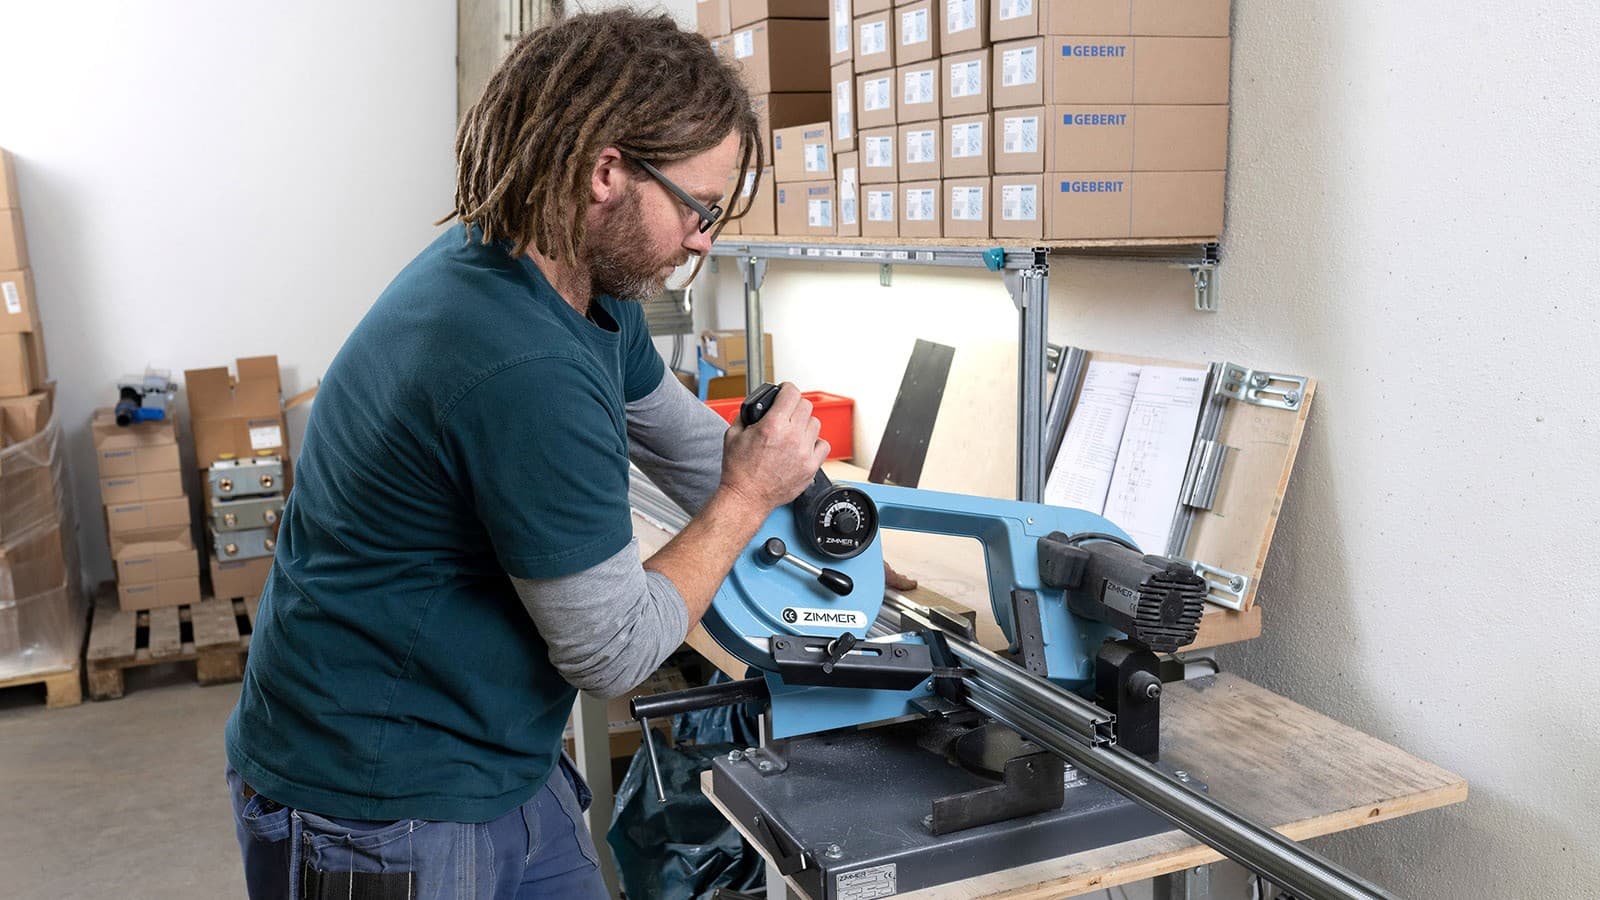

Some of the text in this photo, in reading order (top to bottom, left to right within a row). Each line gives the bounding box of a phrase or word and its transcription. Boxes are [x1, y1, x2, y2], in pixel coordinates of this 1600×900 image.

[1073, 45, 1126, 57] GEBERIT
[1074, 114, 1127, 125] GEBERIT
[1072, 181, 1124, 192] GEBERIT
[826, 537, 853, 546] ZIMMER
[1107, 582, 1132, 598] ZIMMER
[803, 612, 856, 623] ZIMMER
